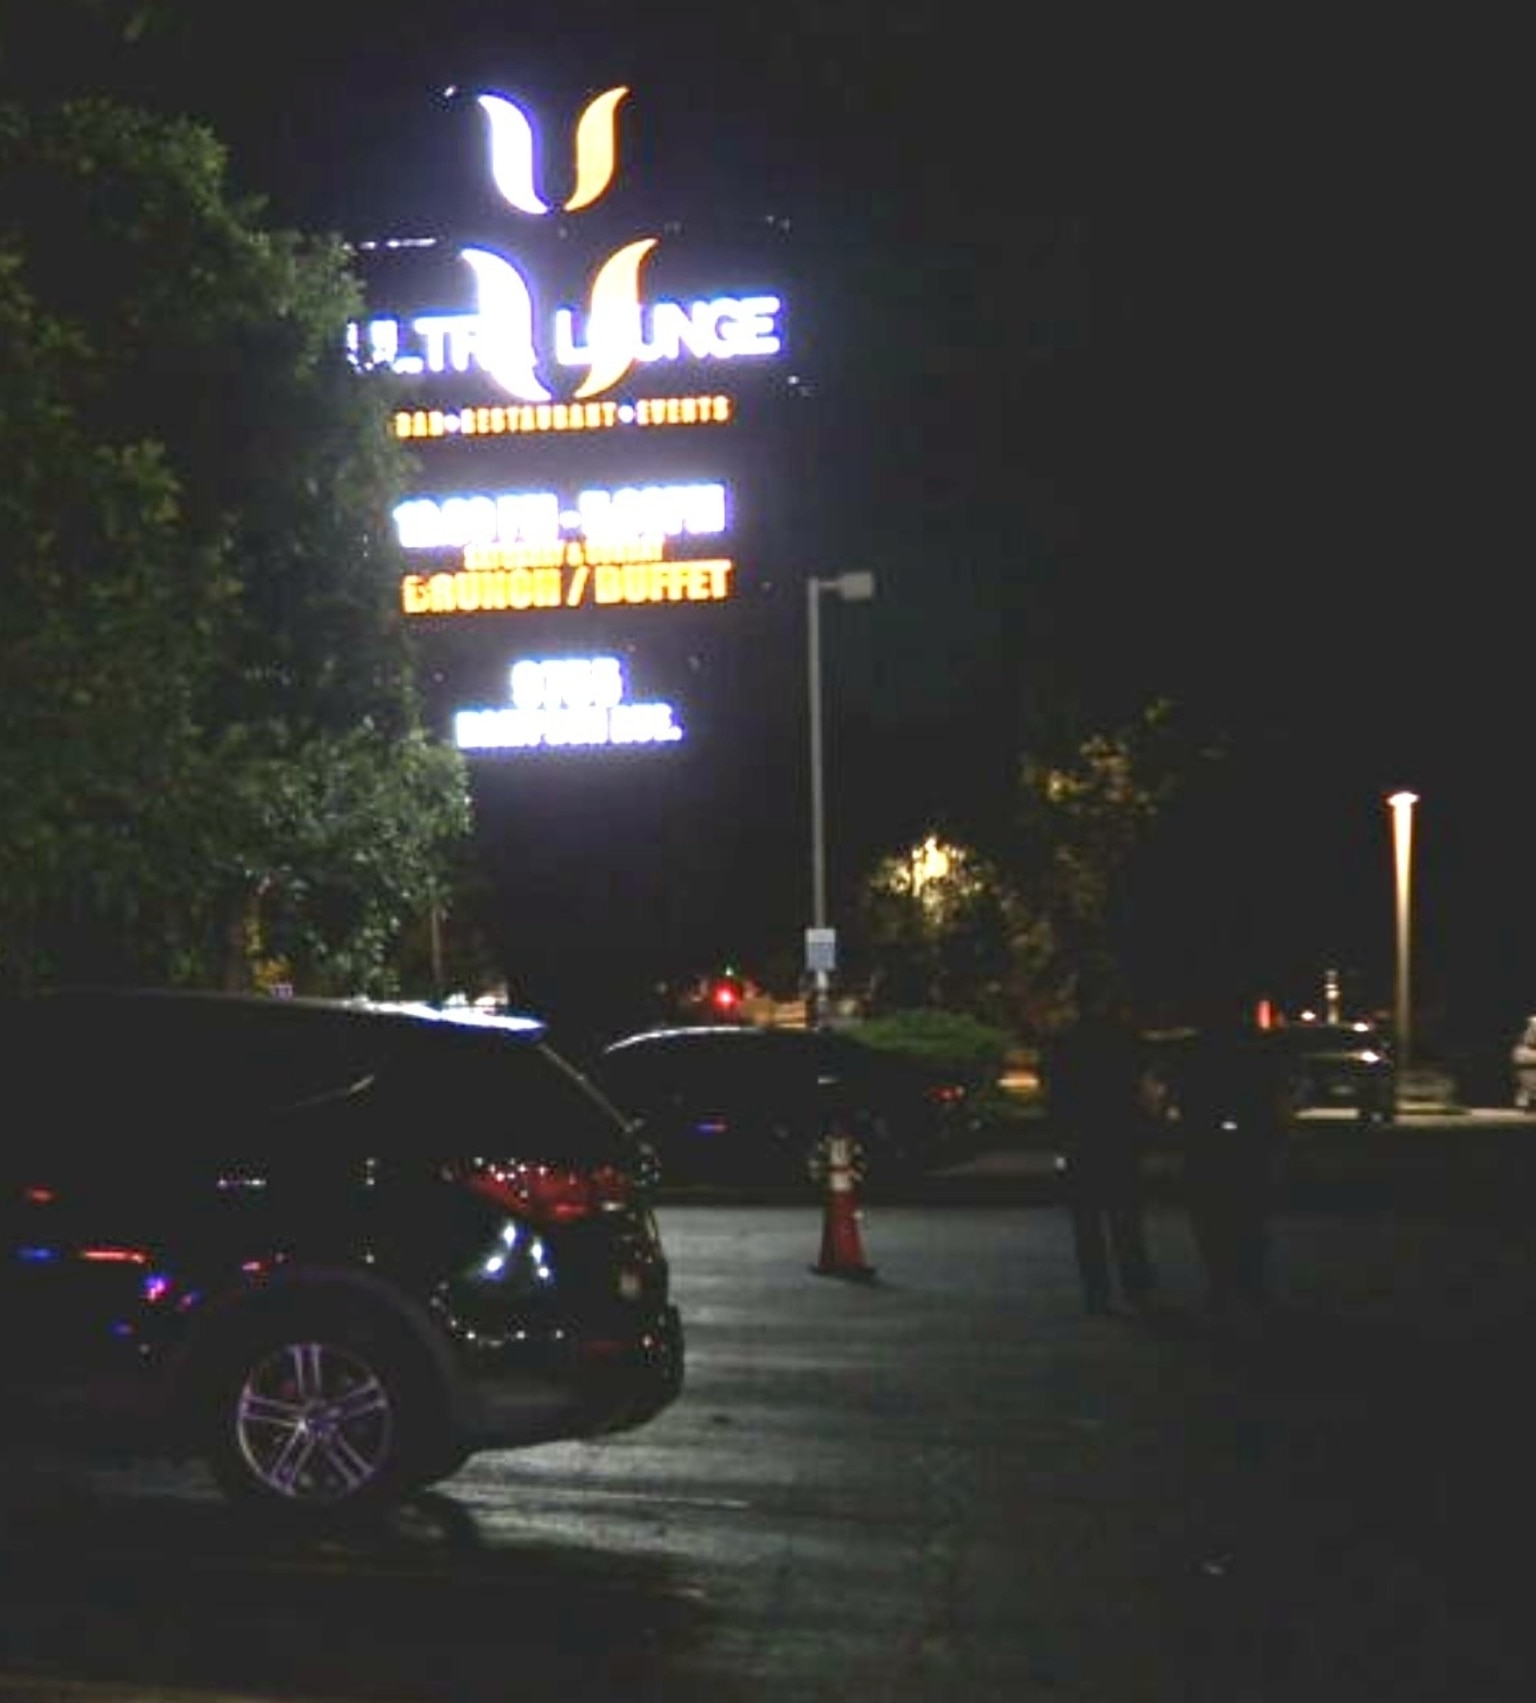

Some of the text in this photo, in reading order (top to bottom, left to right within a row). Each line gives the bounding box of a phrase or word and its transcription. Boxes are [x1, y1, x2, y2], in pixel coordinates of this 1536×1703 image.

[347, 314, 537, 373] ULTR
[460, 402, 616, 435] RESTAURANT
[637, 396, 728, 425] EVENTS
[595, 560, 731, 604] BUFFET
